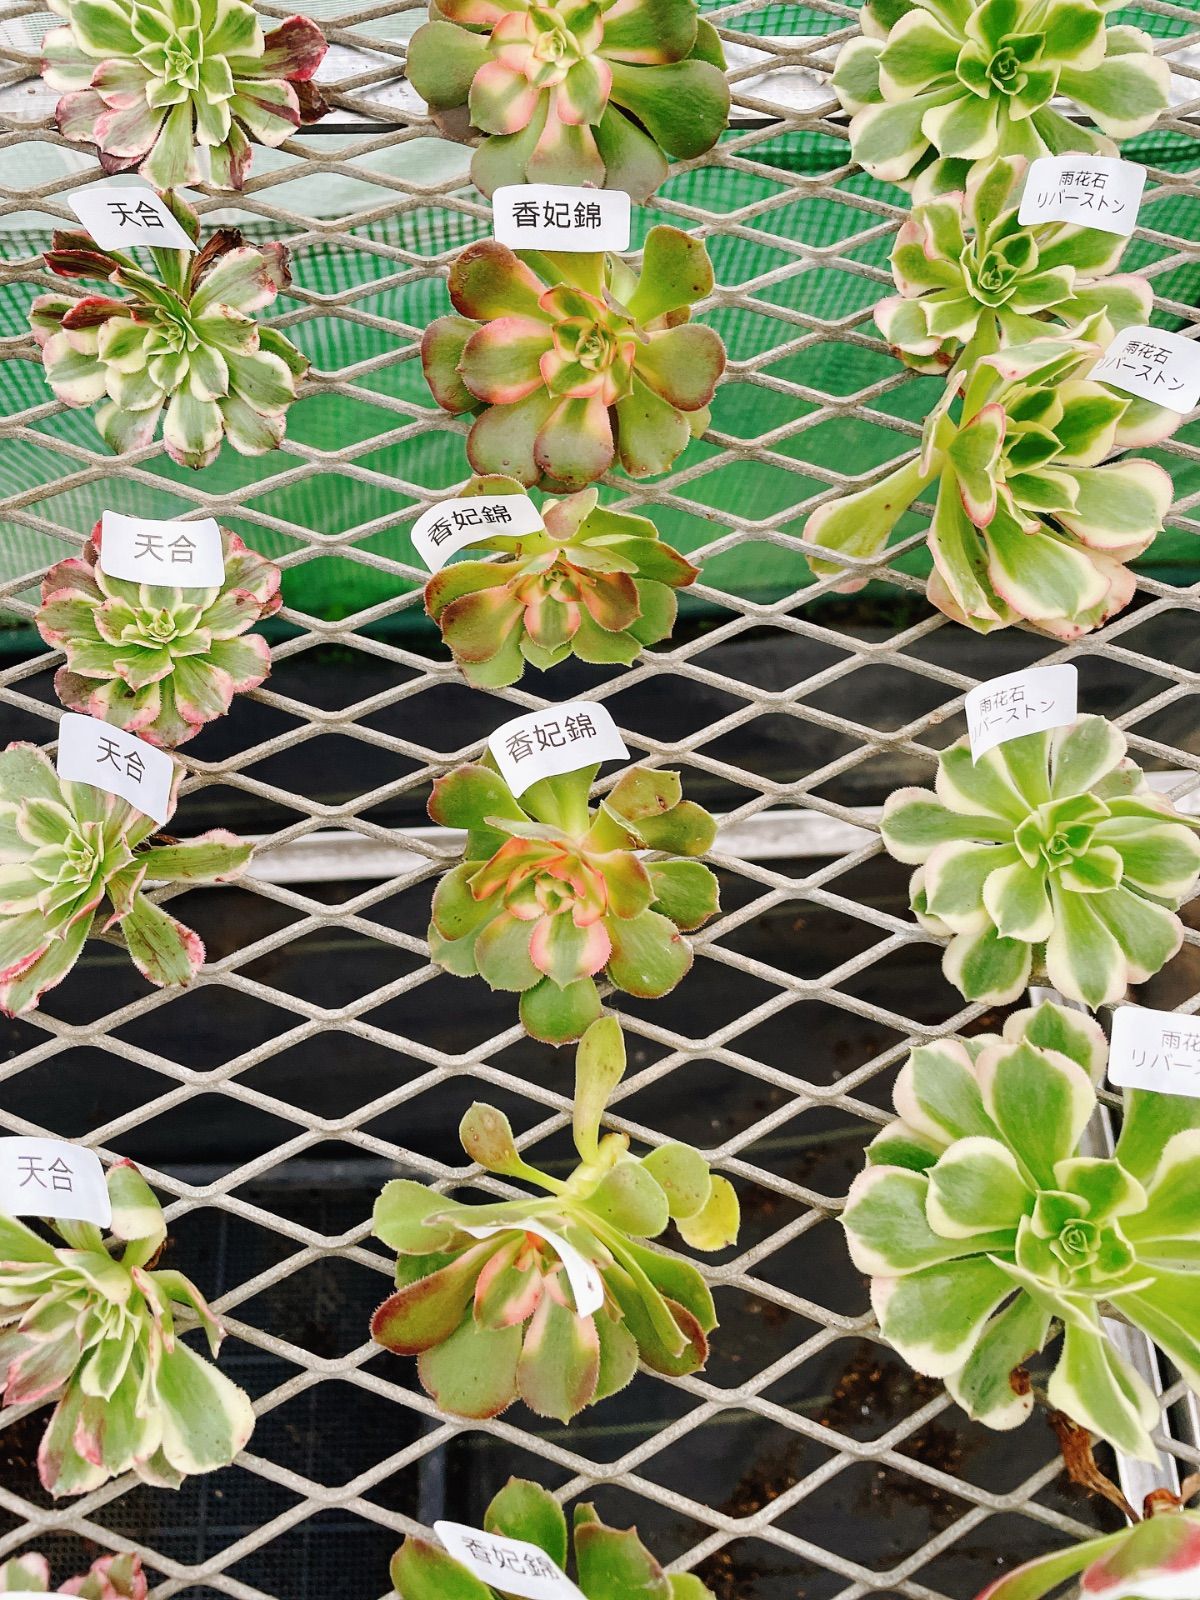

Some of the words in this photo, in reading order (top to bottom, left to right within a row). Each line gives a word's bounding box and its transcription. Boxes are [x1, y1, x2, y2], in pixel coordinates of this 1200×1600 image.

[1059, 170, 1109, 189] 雨花石
[107, 201, 164, 228] 天合
[512, 201, 601, 229] 香妃錦
[1037, 189, 1125, 214] リバーストン
[1122, 340, 1173, 364] 雨花石
[427, 504, 512, 546] 香妃錦
[133, 533, 197, 563] 天合
[979, 685, 1025, 716] 雨花石
[505, 713, 596, 764] 香妃錦
[96, 736, 145, 784] 天合
[18, 1156, 74, 1192] 天合
[461, 1536, 559, 1580] 香妃錦
